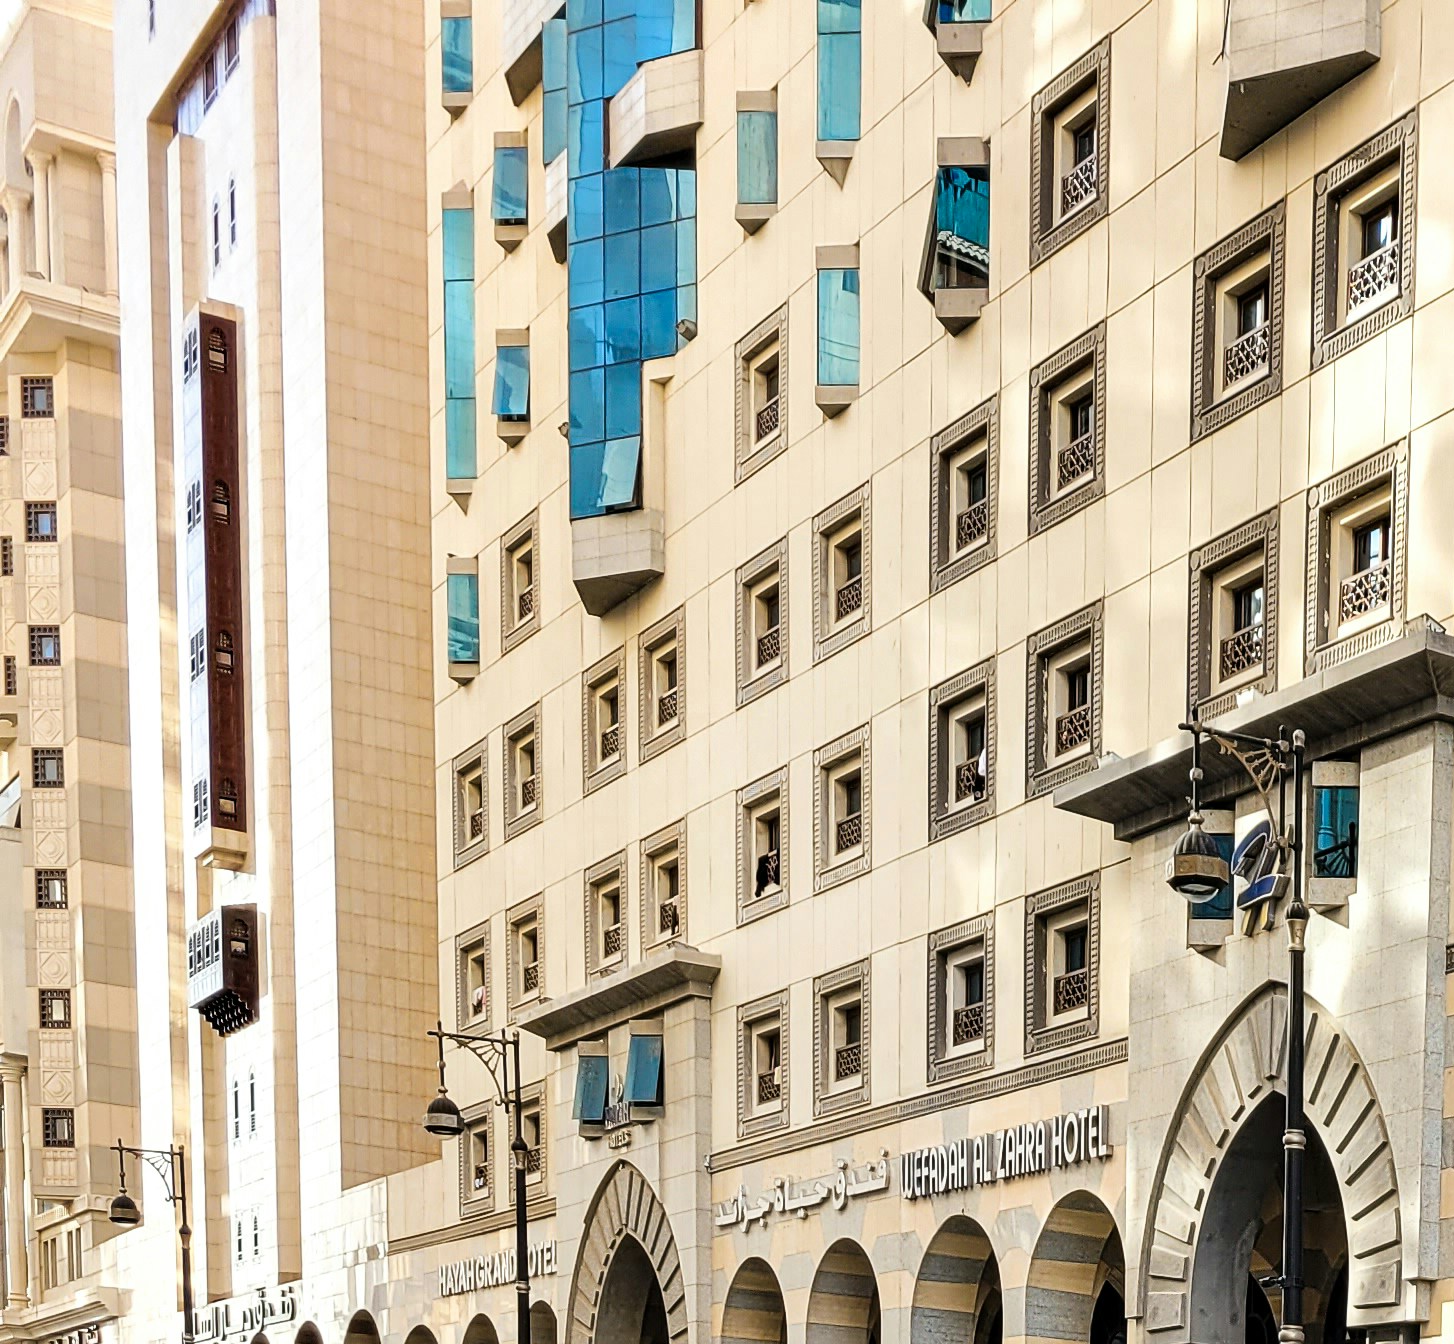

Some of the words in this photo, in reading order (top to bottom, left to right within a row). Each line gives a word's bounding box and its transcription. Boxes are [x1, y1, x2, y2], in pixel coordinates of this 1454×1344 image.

[832, 1149, 890, 1210] فندق
[900, 1139, 971, 1198] WEFADAH
[972, 1133, 993, 1184] AL
[996, 1120, 1049, 1179] ZAHRA
[1052, 1105, 1111, 1167] HOTEL
[774, 1175, 832, 1220] حياة
[439, 1258, 474, 1296] HAYAH
[475, 1248, 518, 1288] GRAND
[527, 1240, 557, 1277] OTEL
